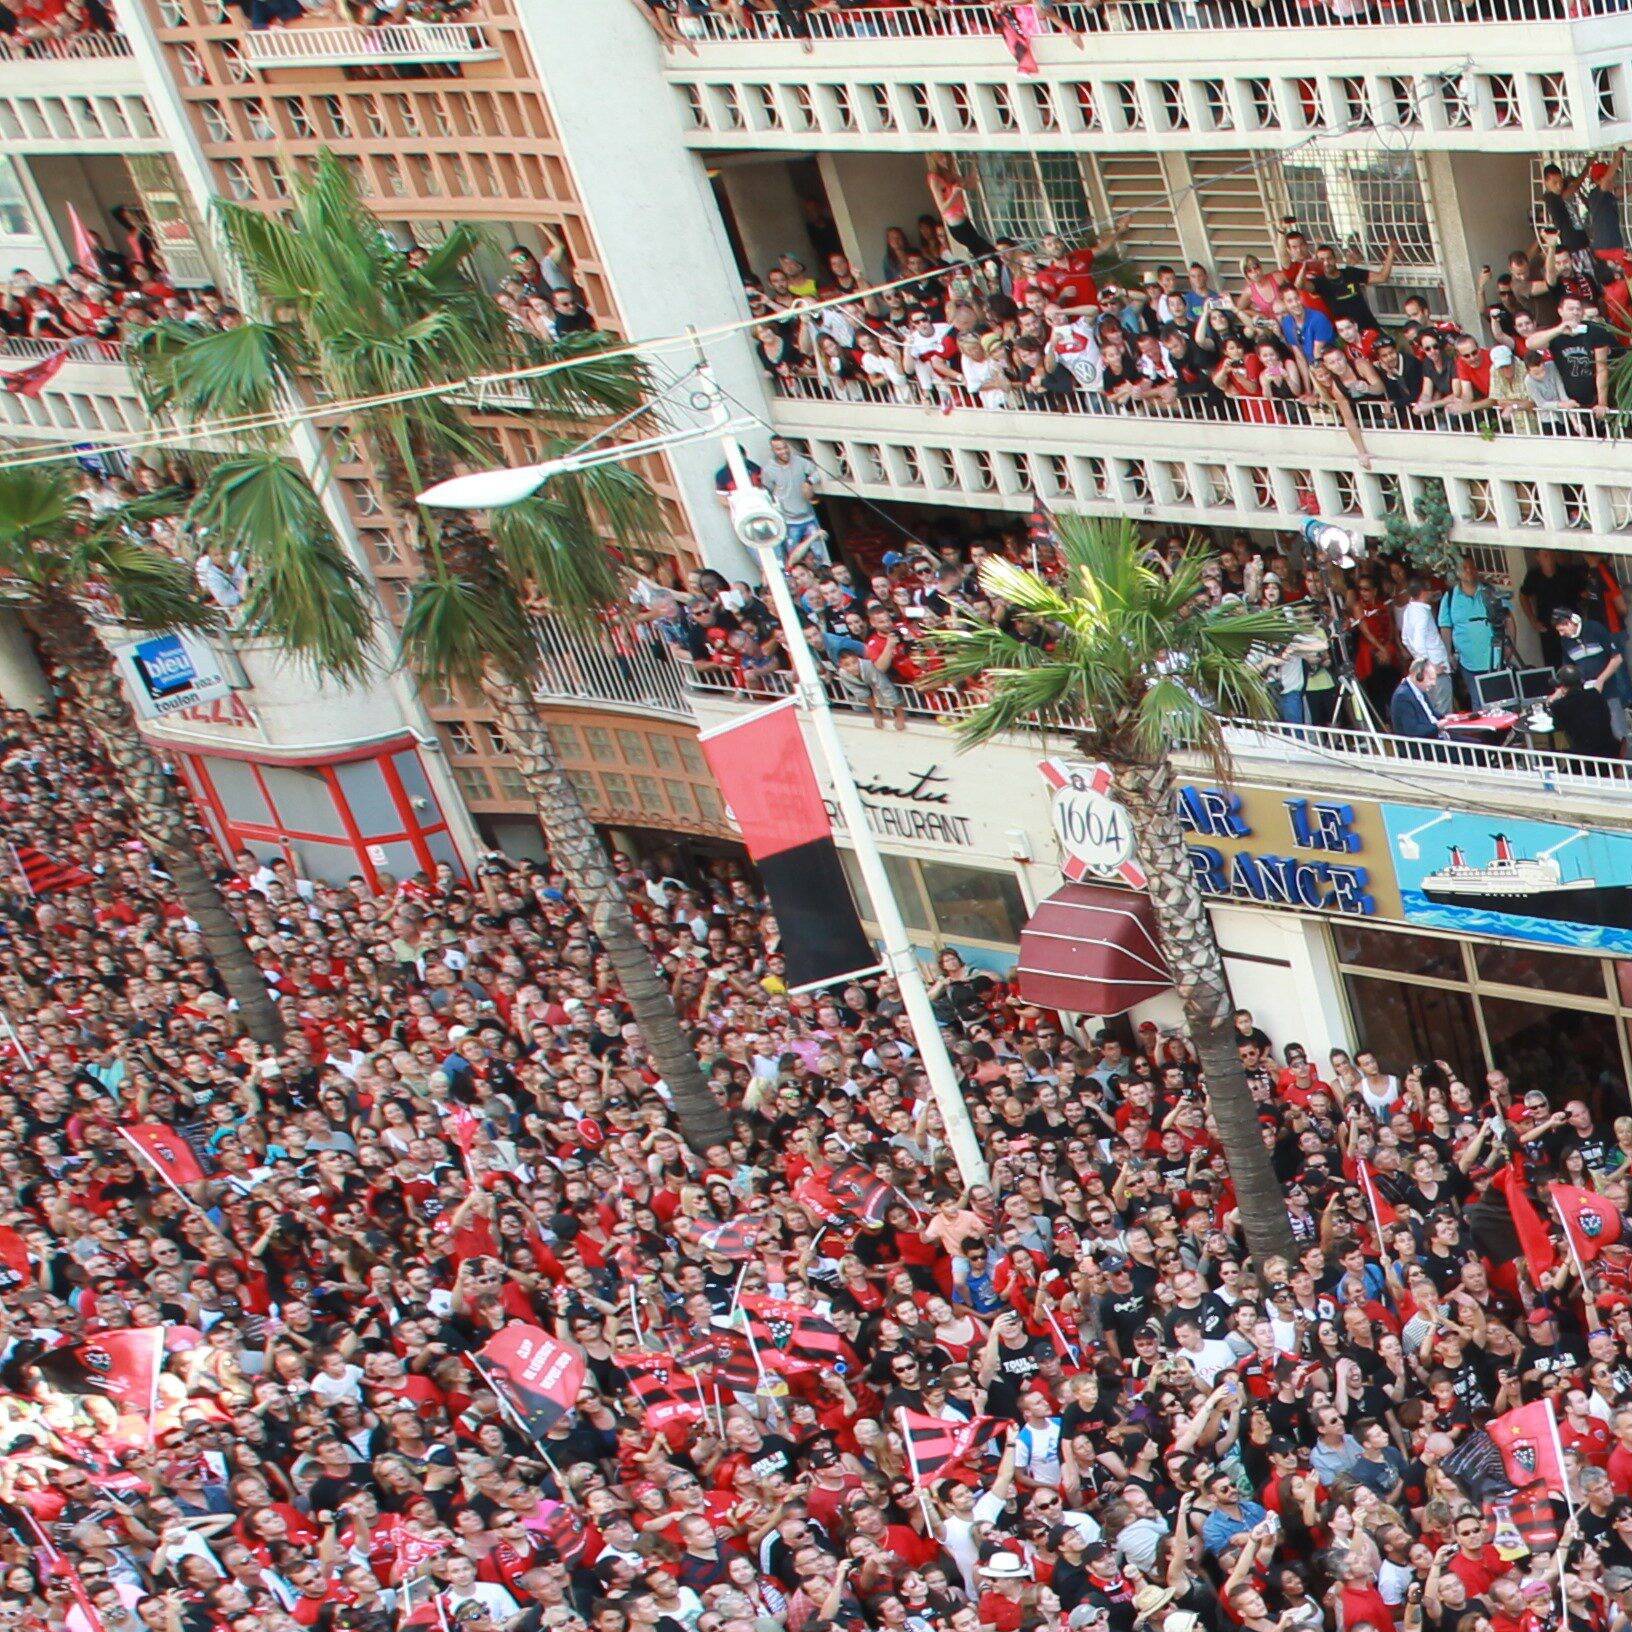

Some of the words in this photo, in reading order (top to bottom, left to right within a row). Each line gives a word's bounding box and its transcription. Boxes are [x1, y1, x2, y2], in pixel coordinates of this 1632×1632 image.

[147, 650, 191, 679] bleu
[152, 693, 199, 713] toulon
[1057, 796, 1123, 856] 1664
[1282, 798, 1361, 855] LE
[1178, 844, 1377, 916] RANCE
